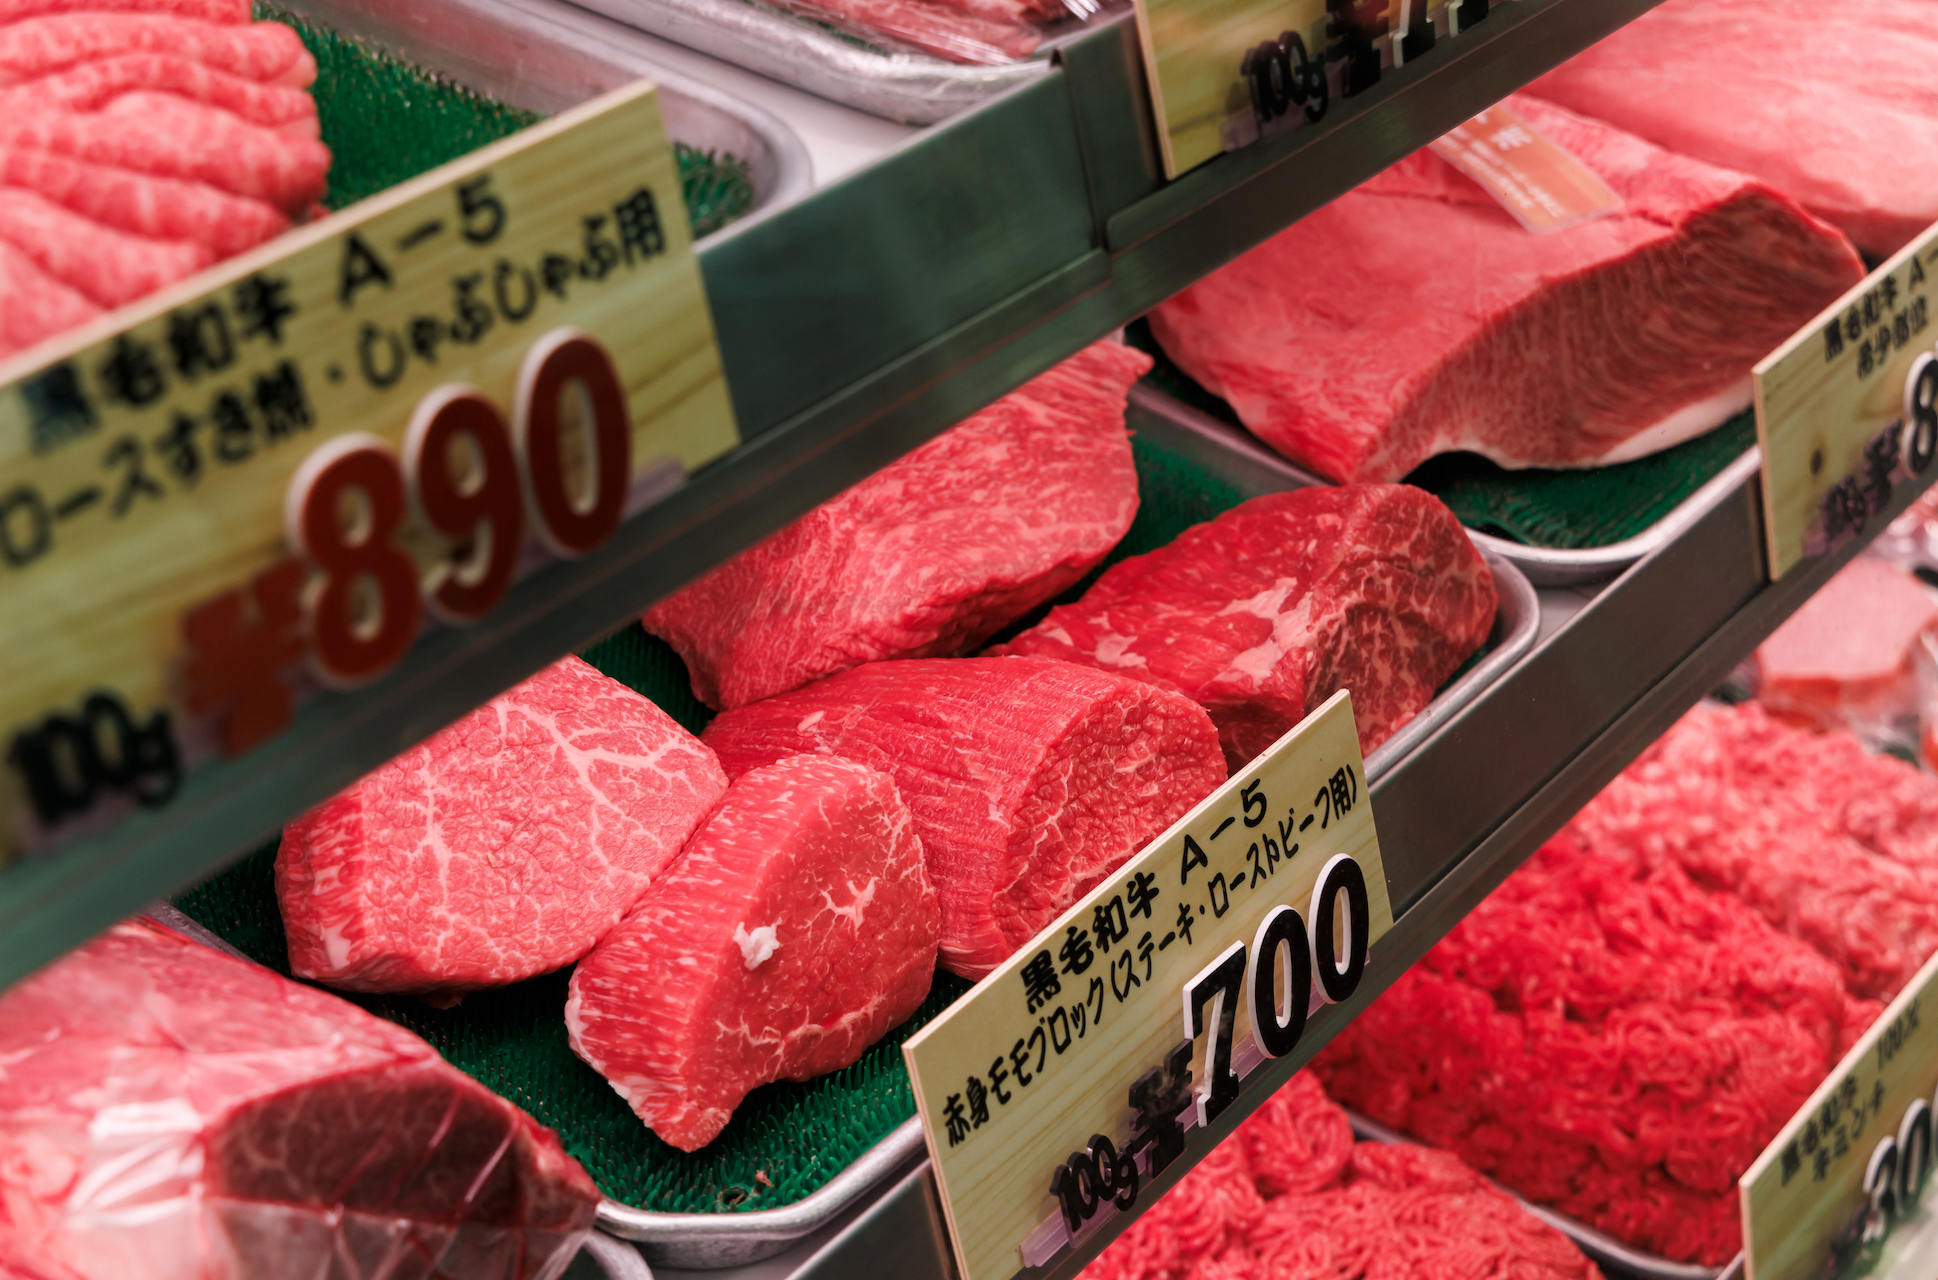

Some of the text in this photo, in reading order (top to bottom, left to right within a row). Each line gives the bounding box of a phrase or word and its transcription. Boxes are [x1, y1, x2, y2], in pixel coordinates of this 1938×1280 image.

[22, 272, 297, 455] 黒毛和牛
[1020, 872, 1160, 1015] 黒毛和牛
[1049, 1133, 1140, 1233] 100g
